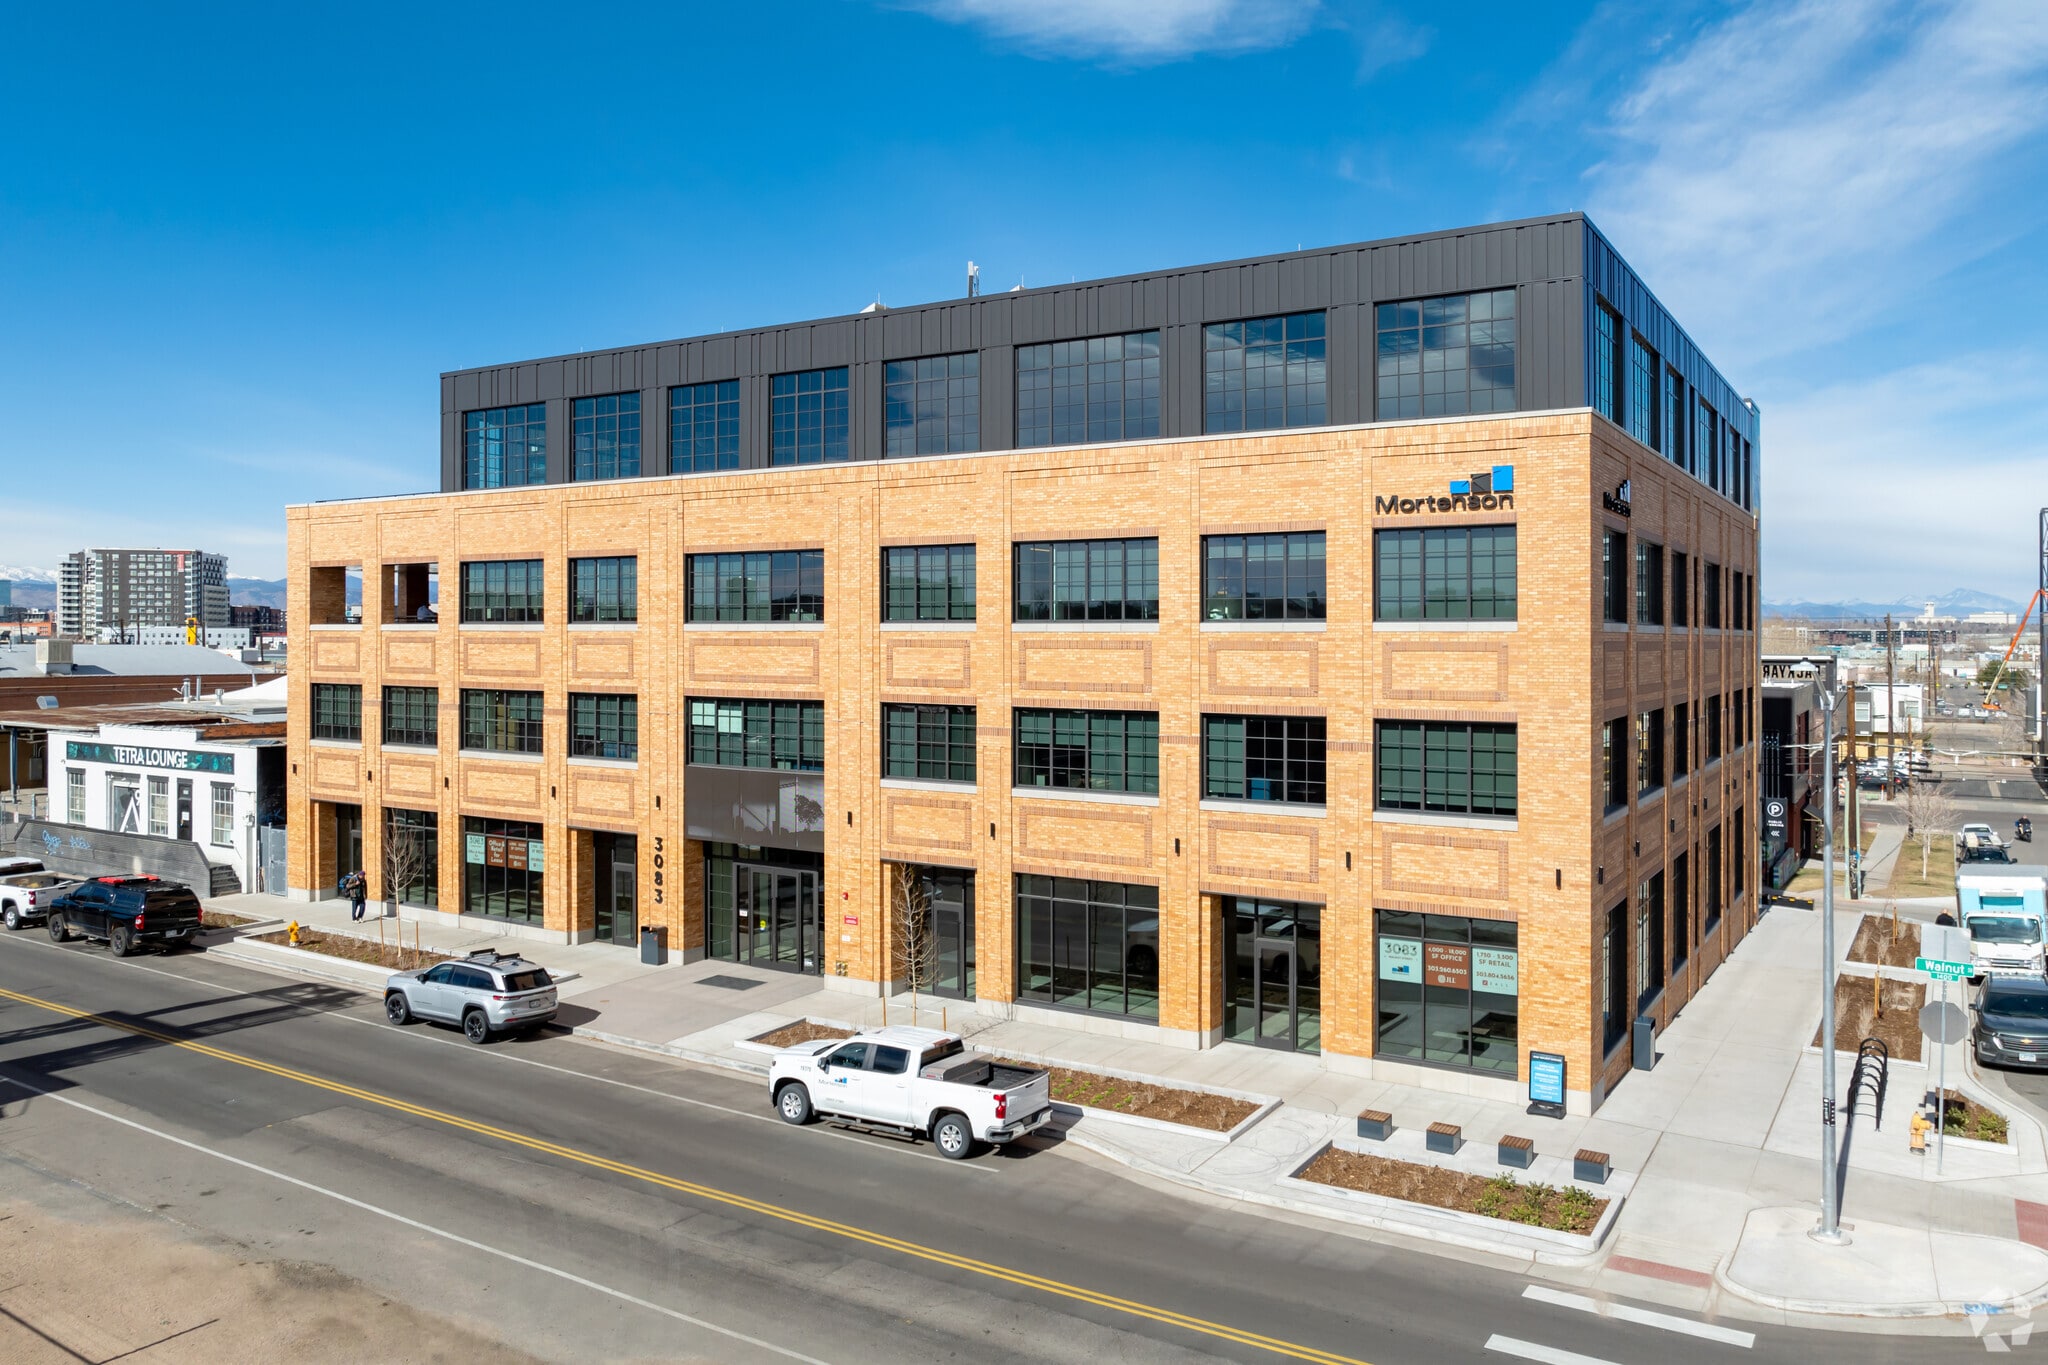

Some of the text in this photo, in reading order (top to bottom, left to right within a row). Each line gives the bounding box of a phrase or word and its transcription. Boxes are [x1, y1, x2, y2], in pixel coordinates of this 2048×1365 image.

[1375, 494, 1514, 515] Mortenson
[113, 746, 187, 768] TETRA LOUNGE
[654, 836, 664, 904] 3083
[1384, 942, 1417, 957] 3083
[1440, 954, 1462, 962] OFFICE
[1488, 959, 1512, 968] RETAIL
[1925, 961, 1964, 974] Walnut
